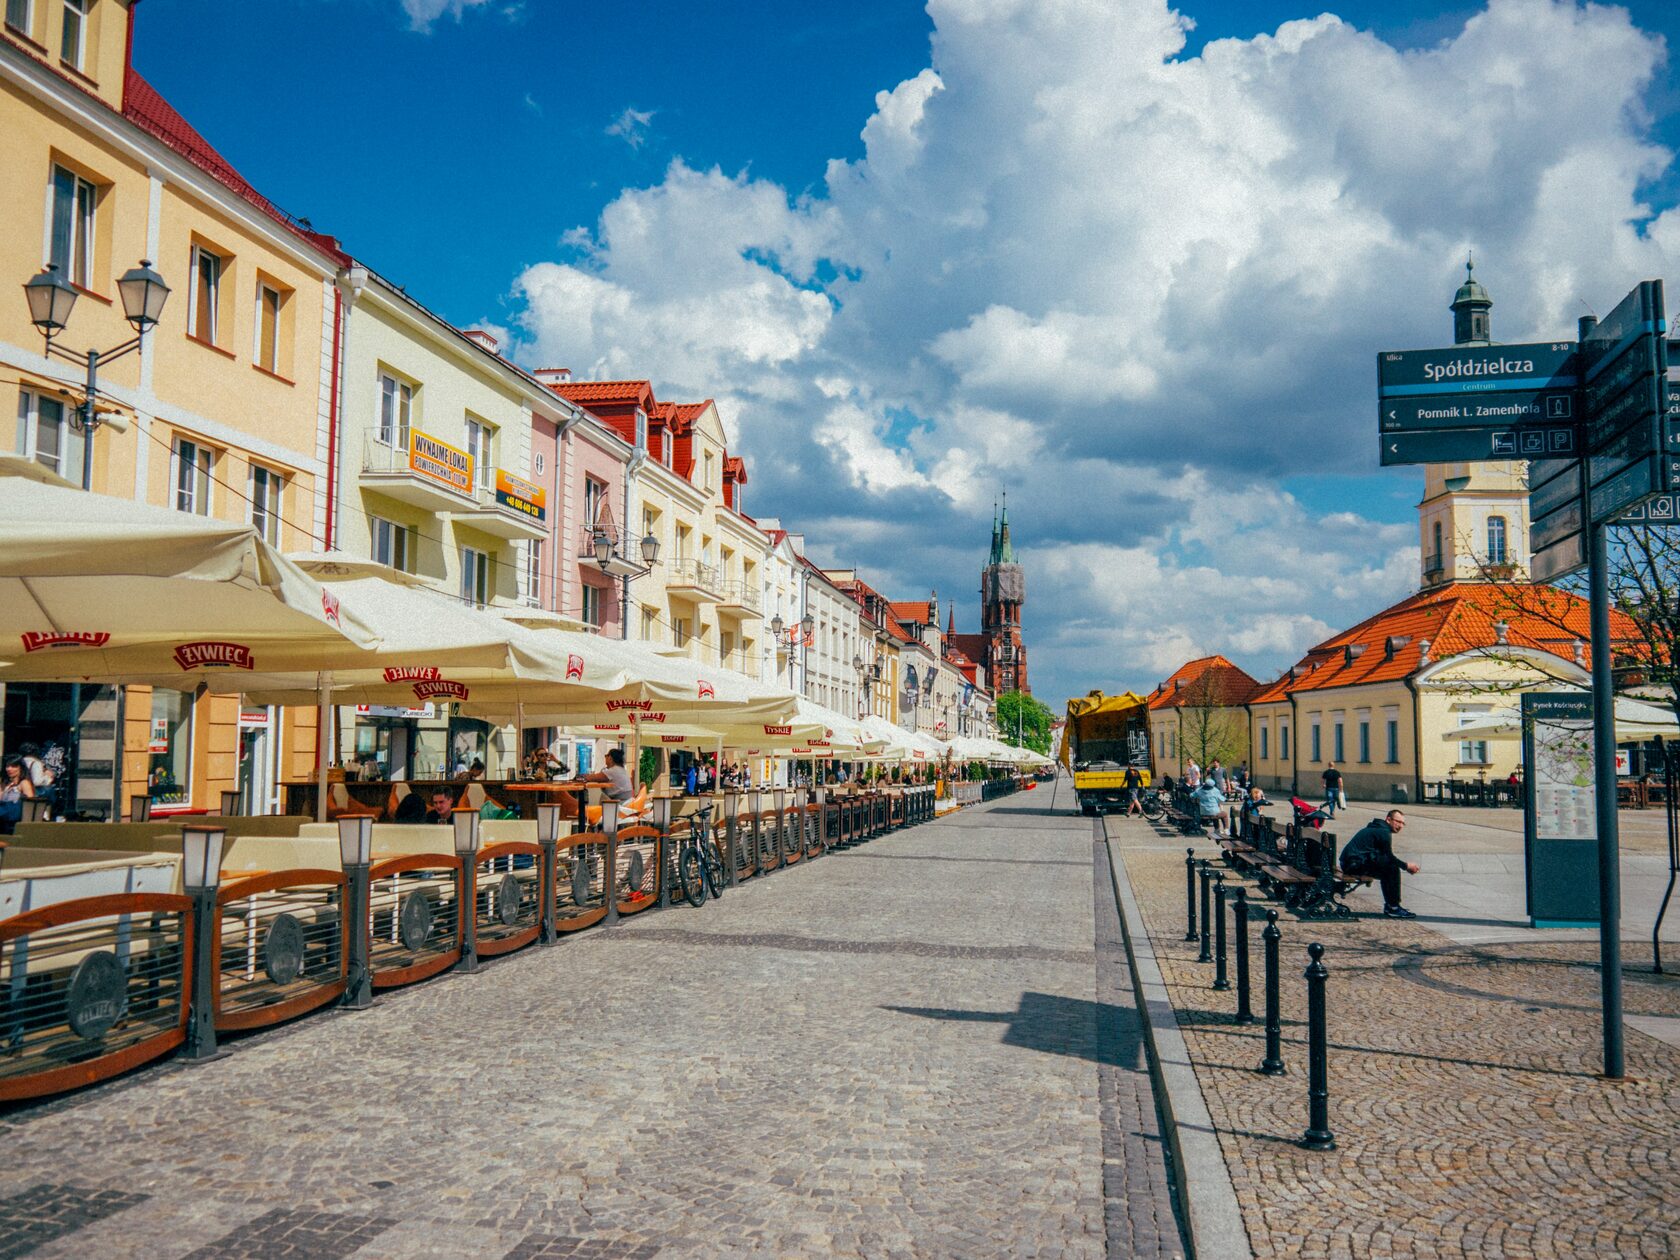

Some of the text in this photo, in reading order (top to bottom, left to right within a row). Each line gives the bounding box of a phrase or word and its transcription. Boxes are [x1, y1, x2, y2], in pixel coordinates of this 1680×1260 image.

[1552, 343, 1569, 351] 8-10
[1423, 357, 1534, 382] Spółdzielcza
[1462, 382, 1496, 391] Centrum
[1418, 402, 1540, 419] Pomnik L. Zamenhofa
[449, 450, 468, 473] LOKAL
[181, 644, 244, 664] ŻYWIEC
[419, 681, 462, 695] ŻYWIEC
[766, 726, 790, 734] TYSKIE
